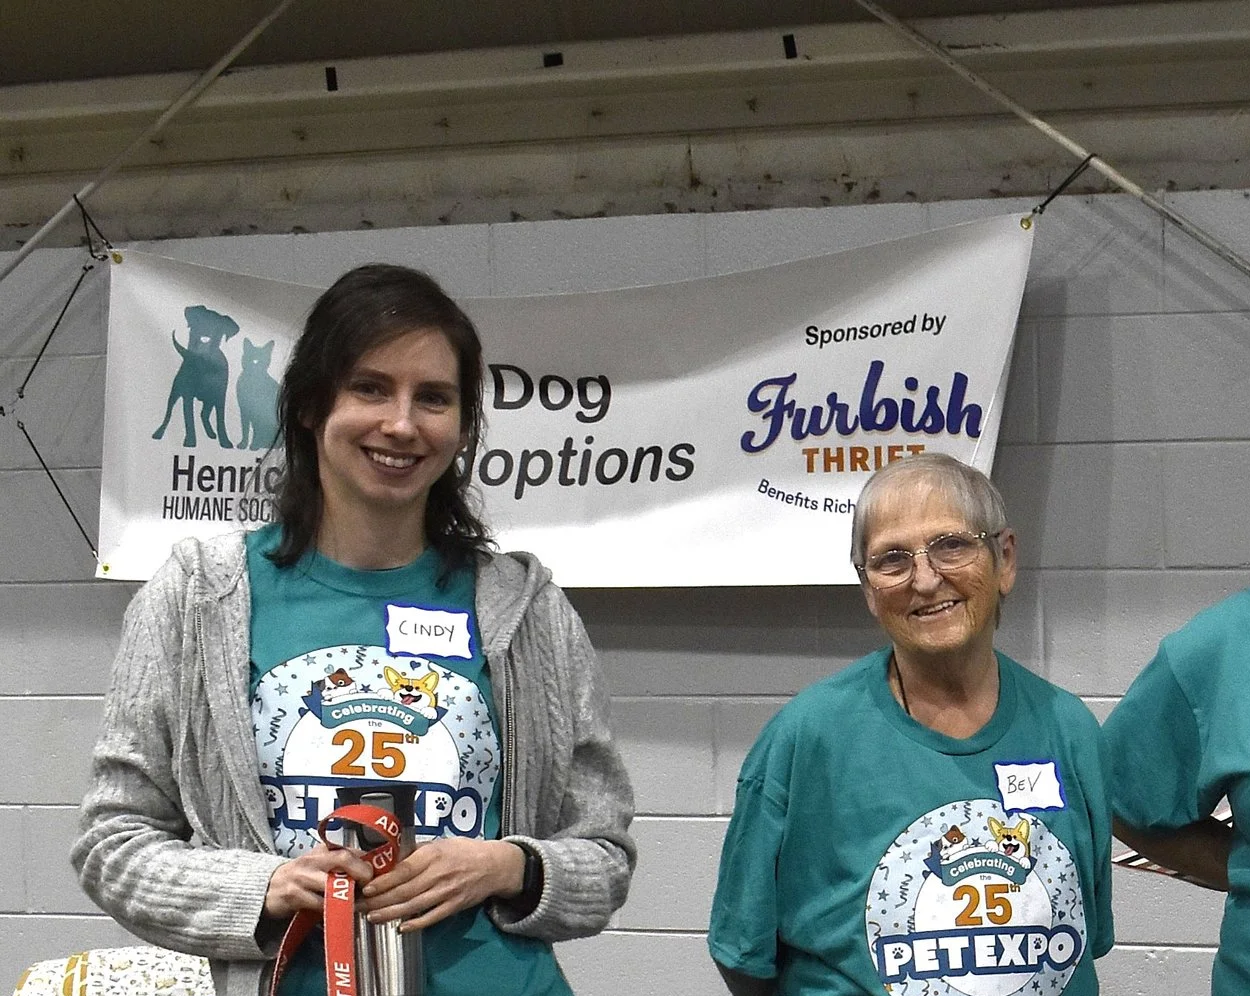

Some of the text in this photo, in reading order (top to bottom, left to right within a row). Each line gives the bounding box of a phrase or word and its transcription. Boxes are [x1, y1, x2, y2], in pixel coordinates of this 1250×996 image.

[804, 312, 947, 349] Sponsored by
[487, 363, 612, 424] Dog
[740, 360, 983, 454] Furbish
[162, 495, 233, 522] HUMANE
[757, 478, 819, 511] Benefits
[398, 620, 455, 642] CINDY
[331, 703, 415, 726] Celebrating
[368, 720, 383, 728] the
[330, 728, 420, 779] 25th
[949, 856, 1016, 878] Celebrating
[952, 882, 1021, 927] 25th
[334, 962, 353, 986] ME
